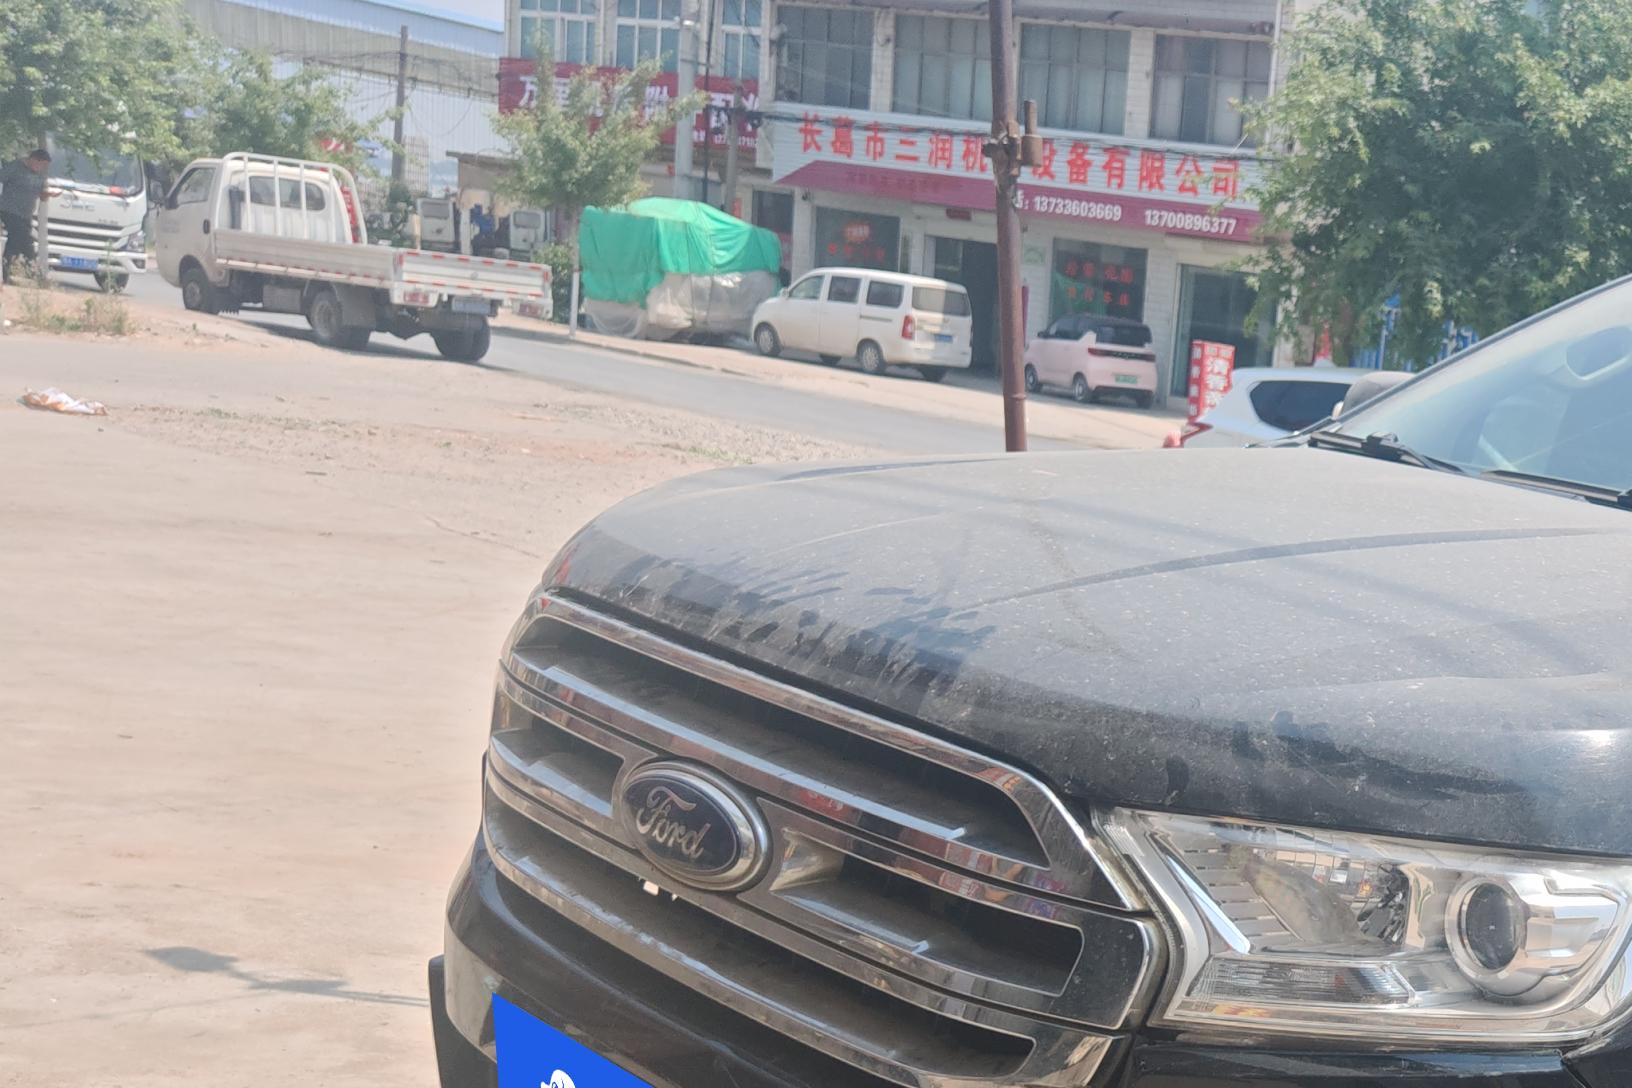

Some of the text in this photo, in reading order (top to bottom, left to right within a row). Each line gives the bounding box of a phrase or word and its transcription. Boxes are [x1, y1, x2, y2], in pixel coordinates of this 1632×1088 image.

[798, 112, 1240, 200] 长葛市三润机设备有限公司
[1144, 209, 1237, 235] 13700896377
[636, 786, 711, 859] Ford
